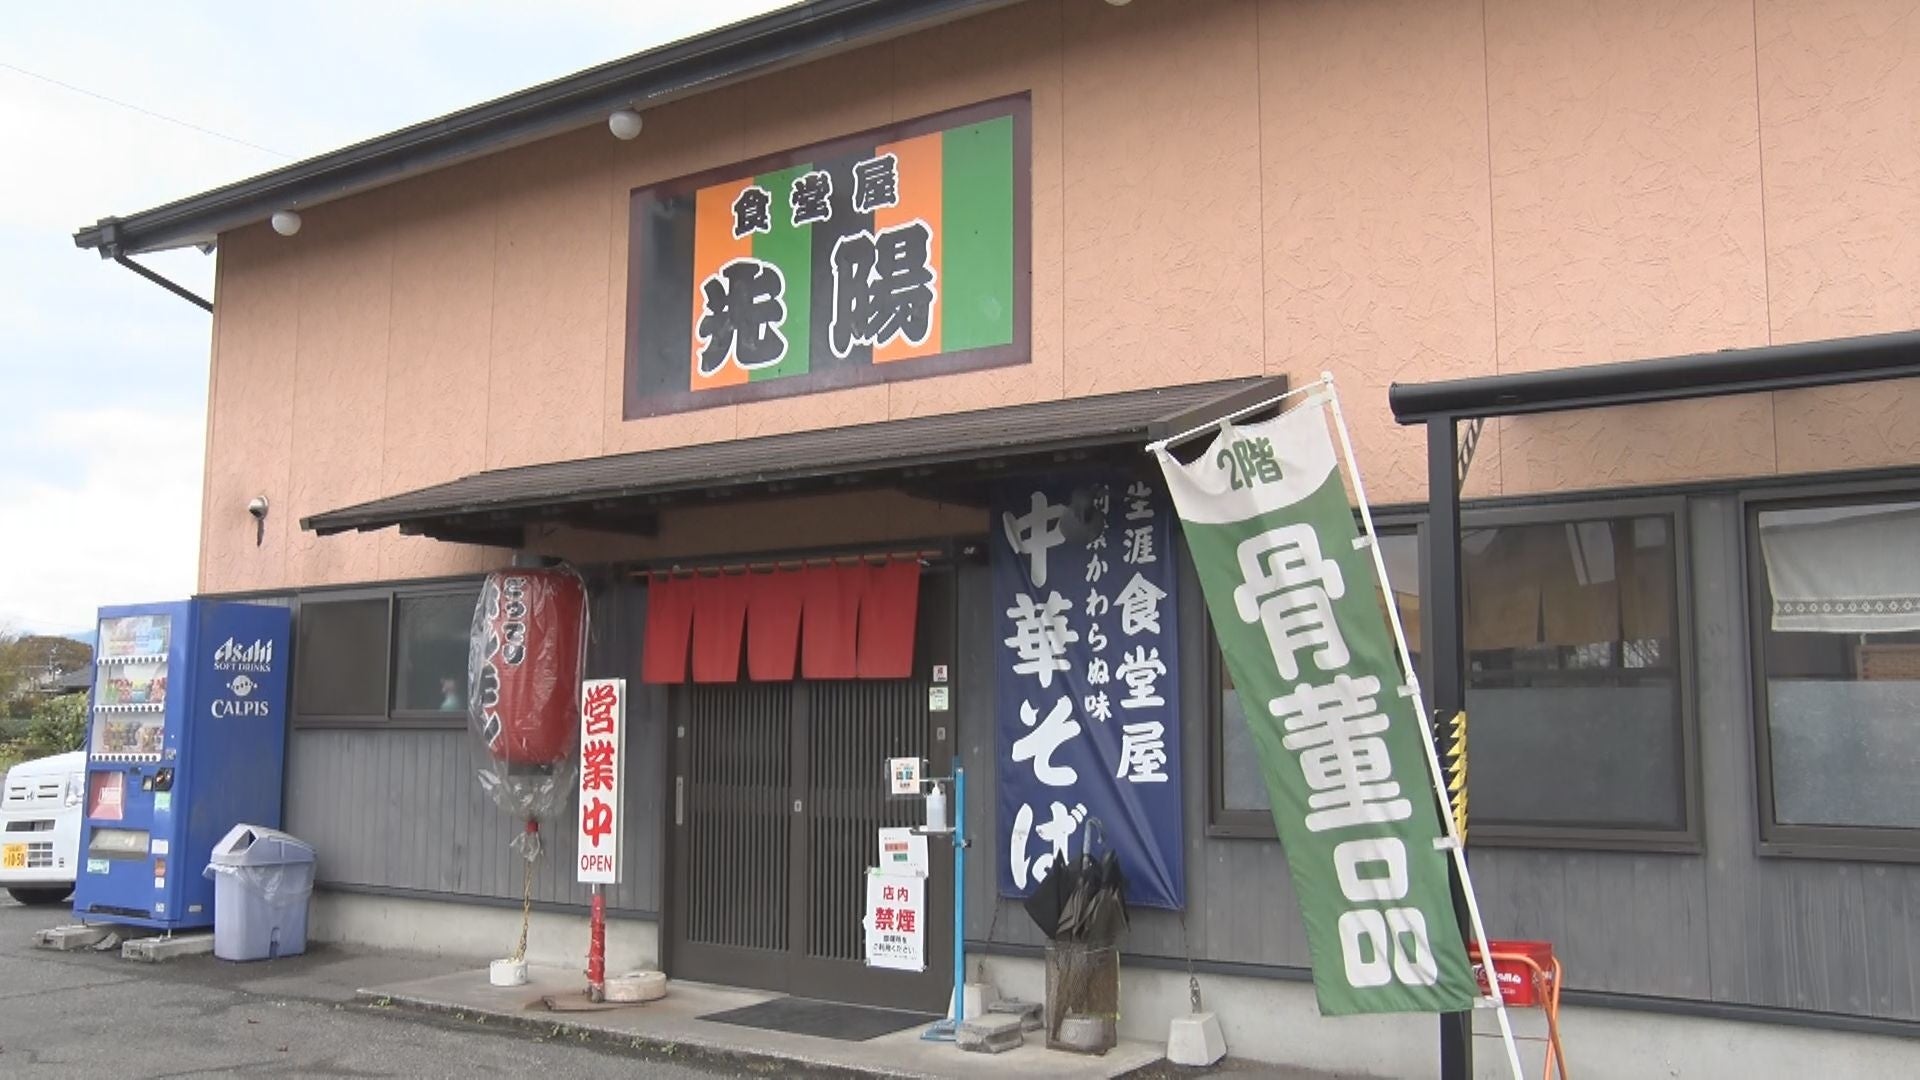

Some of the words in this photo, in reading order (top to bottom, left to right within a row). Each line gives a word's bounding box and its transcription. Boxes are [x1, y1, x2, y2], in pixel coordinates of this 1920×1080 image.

[732, 153, 899, 239] 食堂屋
[696, 218, 937, 377] 光陽
[1217, 442, 1283, 490] 2階
[214, 637, 272, 663] Asahi
[1113, 481, 1168, 783] 生涯食堂屋
[214, 662, 236, 671] SOFT
[238, 663, 271, 672] DRINKS
[1003, 490, 1087, 889] 中華そば
[211, 699, 269, 718] CALPIS
[583, 684, 617, 848] 営業中
[1234, 522, 1439, 988] 骨董品
[580, 854, 613, 872] OPEN
[883, 885, 909, 902] 店内
[875, 907, 916, 933] 禁煙
